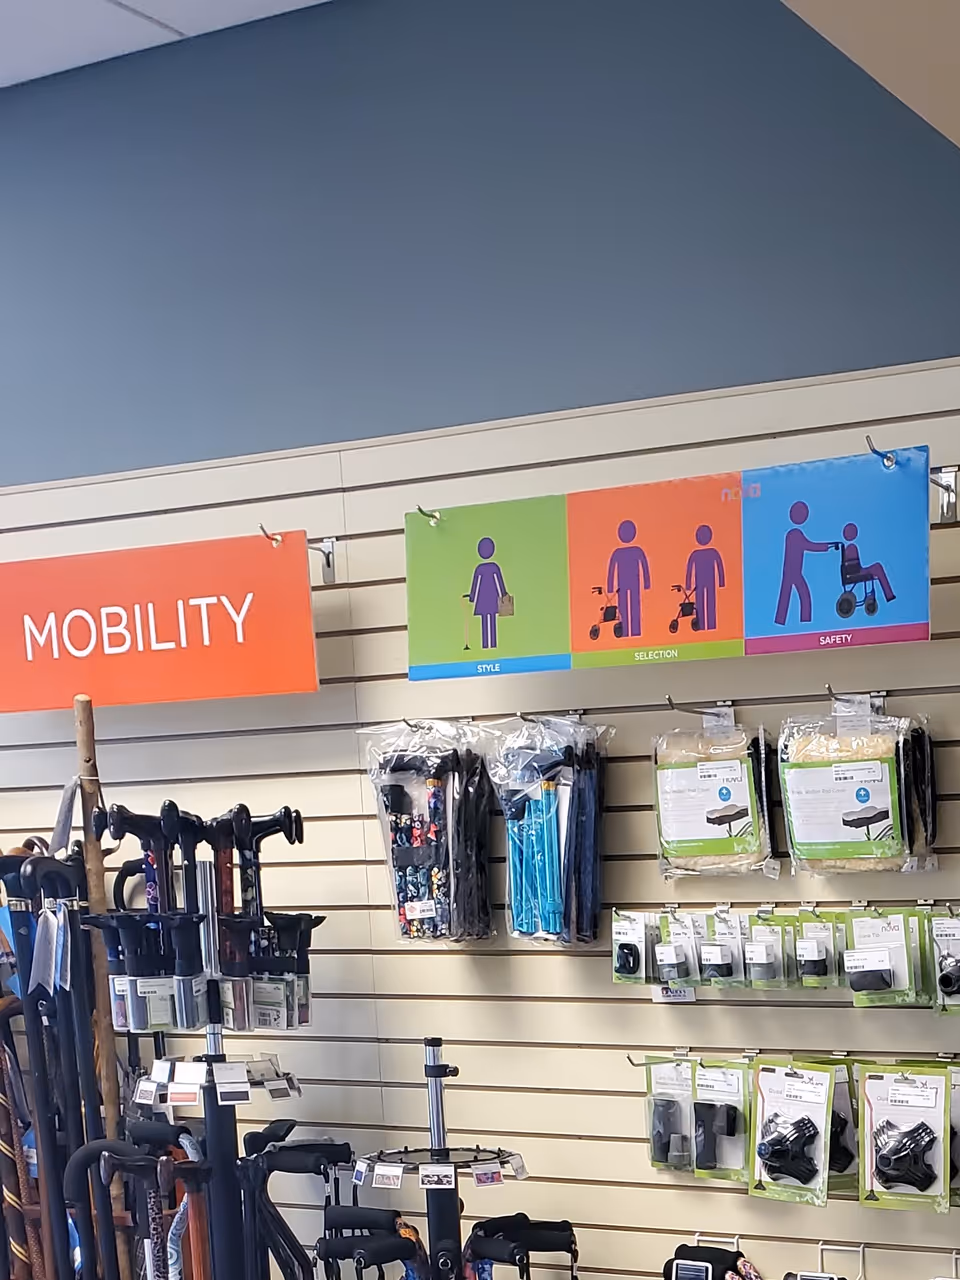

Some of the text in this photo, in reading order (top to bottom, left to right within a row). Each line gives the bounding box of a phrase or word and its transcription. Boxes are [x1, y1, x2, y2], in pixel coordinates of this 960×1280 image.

[22, 592, 254, 661] MOBILITY
[819, 633, 853, 646] SAFETY
[633, 648, 679, 661] SELECTION
[476, 663, 501, 673] STYLE
[881, 924, 900, 933] nova
